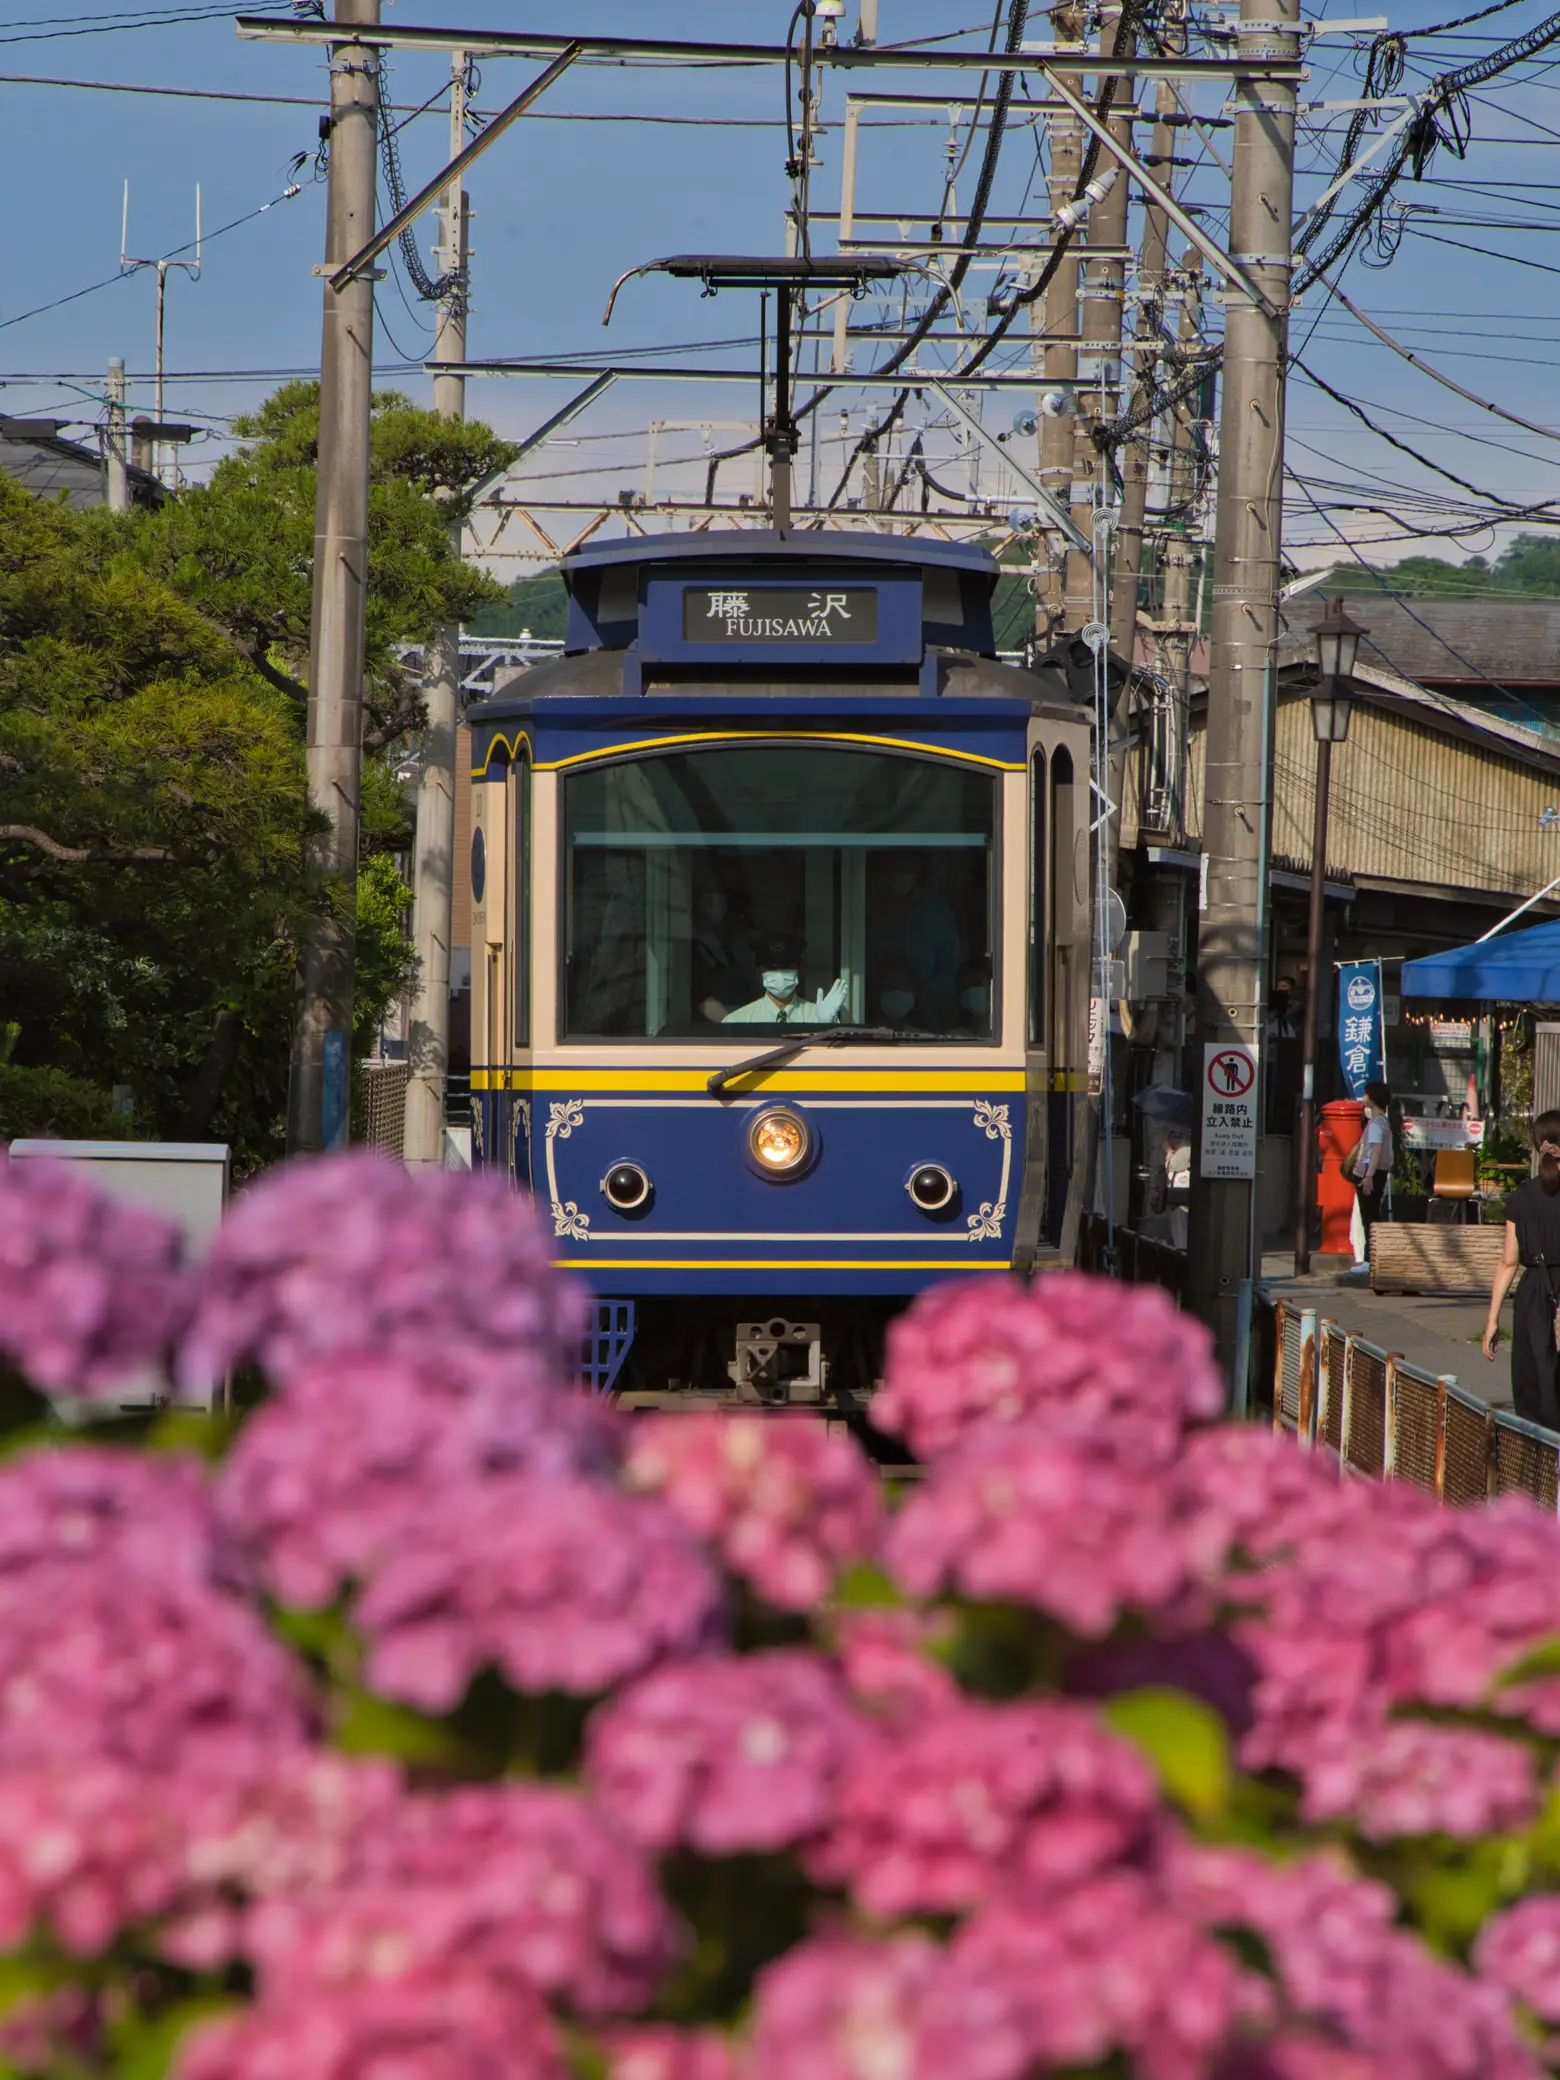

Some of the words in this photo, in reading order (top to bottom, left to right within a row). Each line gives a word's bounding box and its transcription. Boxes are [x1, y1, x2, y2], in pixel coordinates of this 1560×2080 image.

[706, 592, 851, 618] 藤沢
[726, 619, 832, 636] FUJISAWA
[1213, 1103, 1247, 1115] 線路内
[1206, 1116, 1253, 1128] 立入禁止
[1215, 1132, 1230, 1140] Keep
